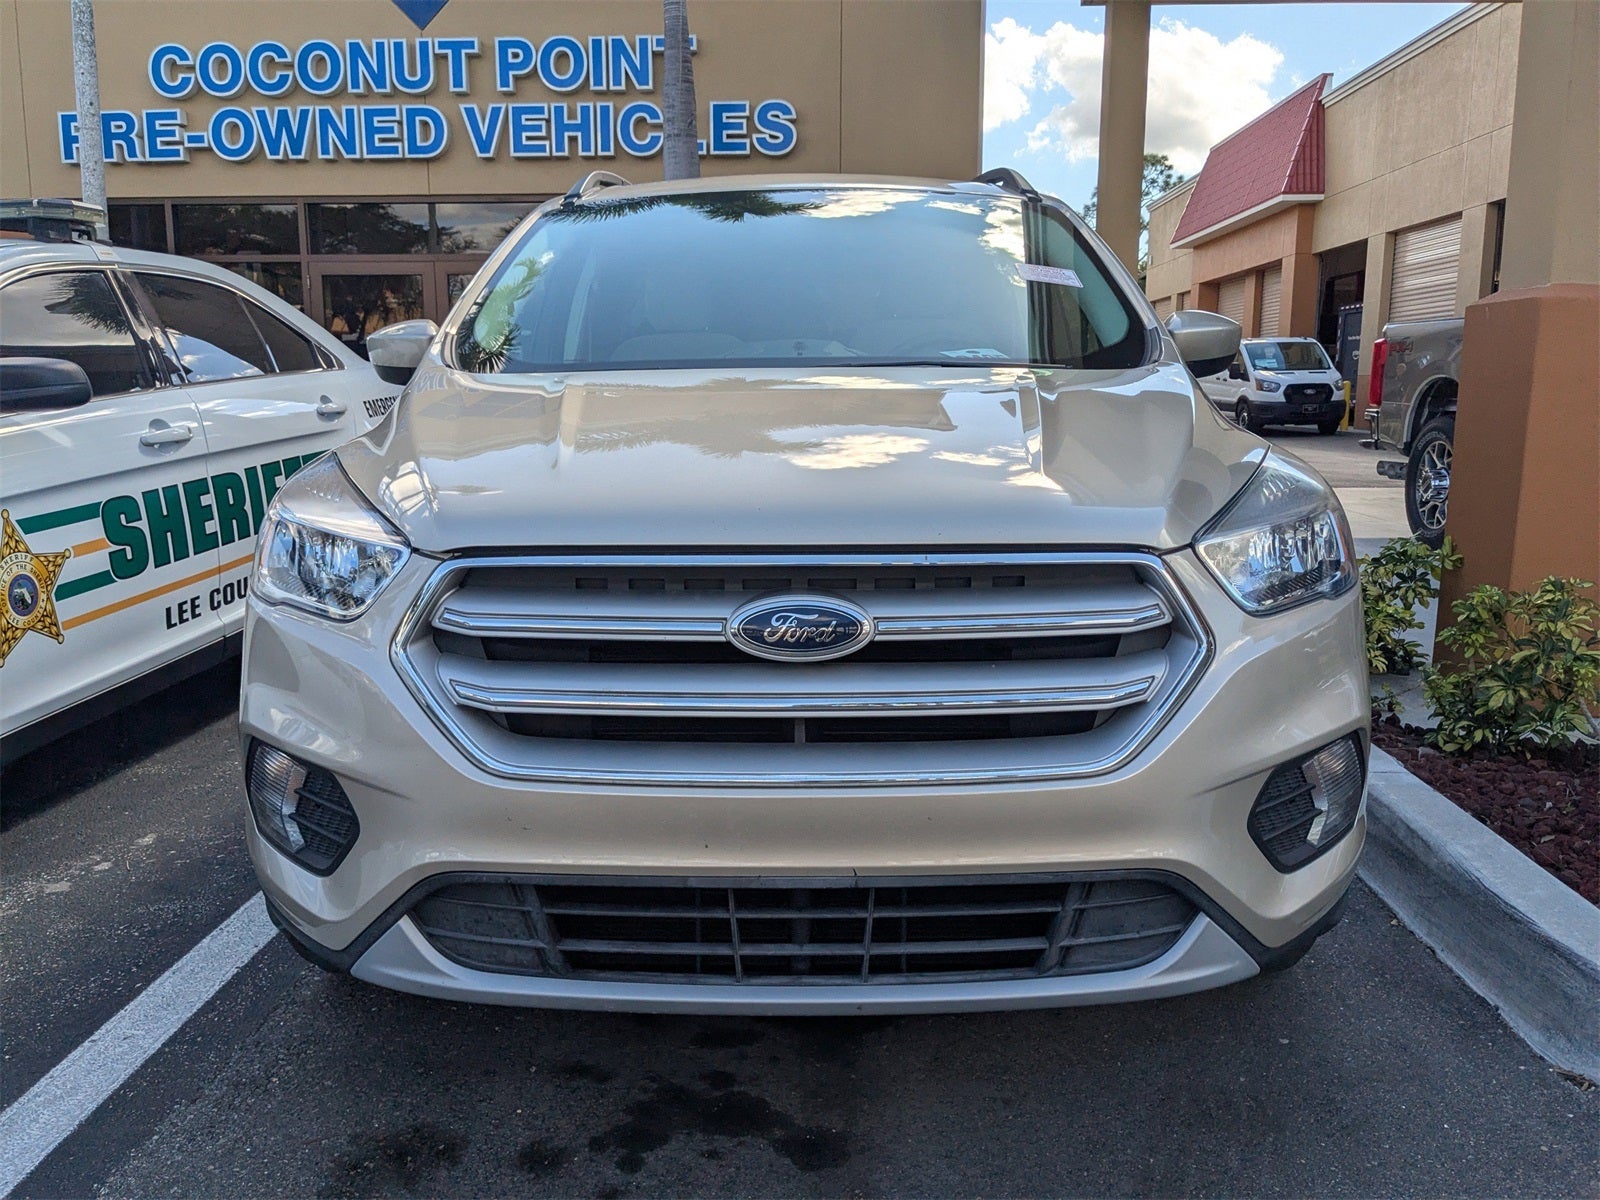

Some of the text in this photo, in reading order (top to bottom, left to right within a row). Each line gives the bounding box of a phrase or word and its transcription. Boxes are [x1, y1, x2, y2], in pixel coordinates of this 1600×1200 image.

[148, 36, 480, 99] COCONUT
[459, 99, 798, 158] VEHICES
[165, 576, 249, 630] LEE COU
[763, 612, 838, 643] Ford
